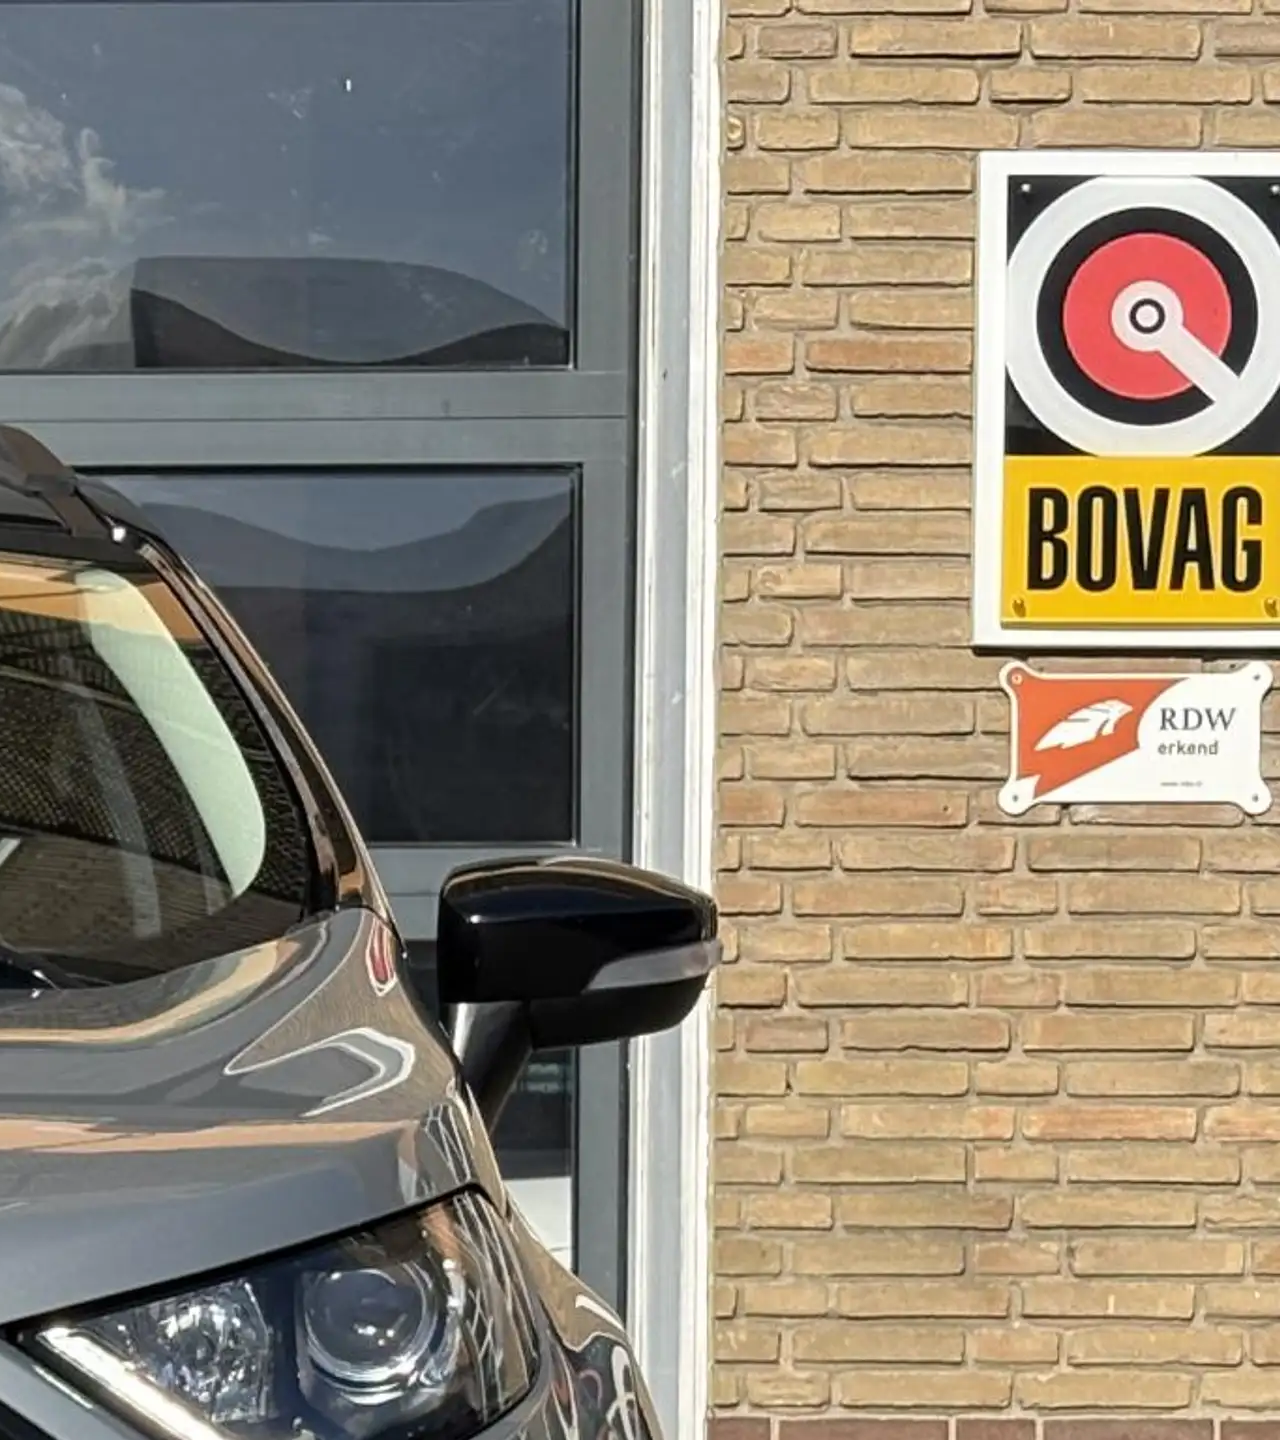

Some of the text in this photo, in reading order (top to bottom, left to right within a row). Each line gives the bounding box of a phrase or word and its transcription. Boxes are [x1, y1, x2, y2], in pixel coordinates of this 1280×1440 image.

[1026, 486, 1263, 593] BOVAG
[1159, 707, 1237, 732] RDW
[1157, 740, 1220, 756] erkend
